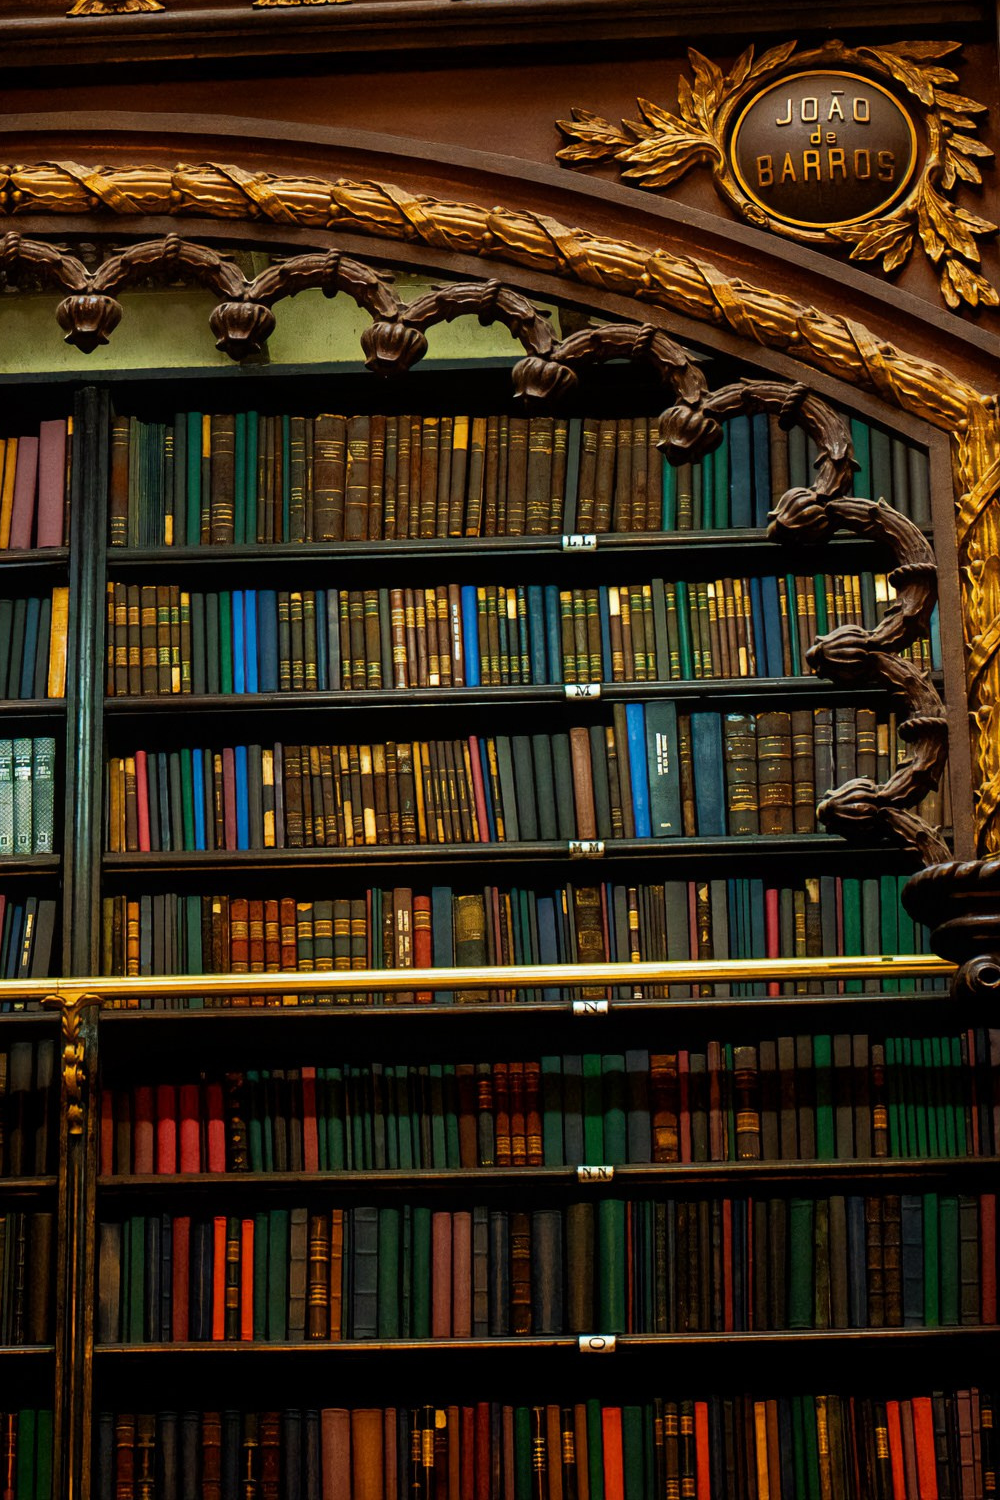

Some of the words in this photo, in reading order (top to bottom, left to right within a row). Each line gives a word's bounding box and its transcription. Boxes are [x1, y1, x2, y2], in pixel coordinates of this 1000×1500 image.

[810, 124, 837, 144] de
[756, 148, 896, 187] BARROS
[574, 685, 592, 697] M
[583, 1001, 599, 1013] N
